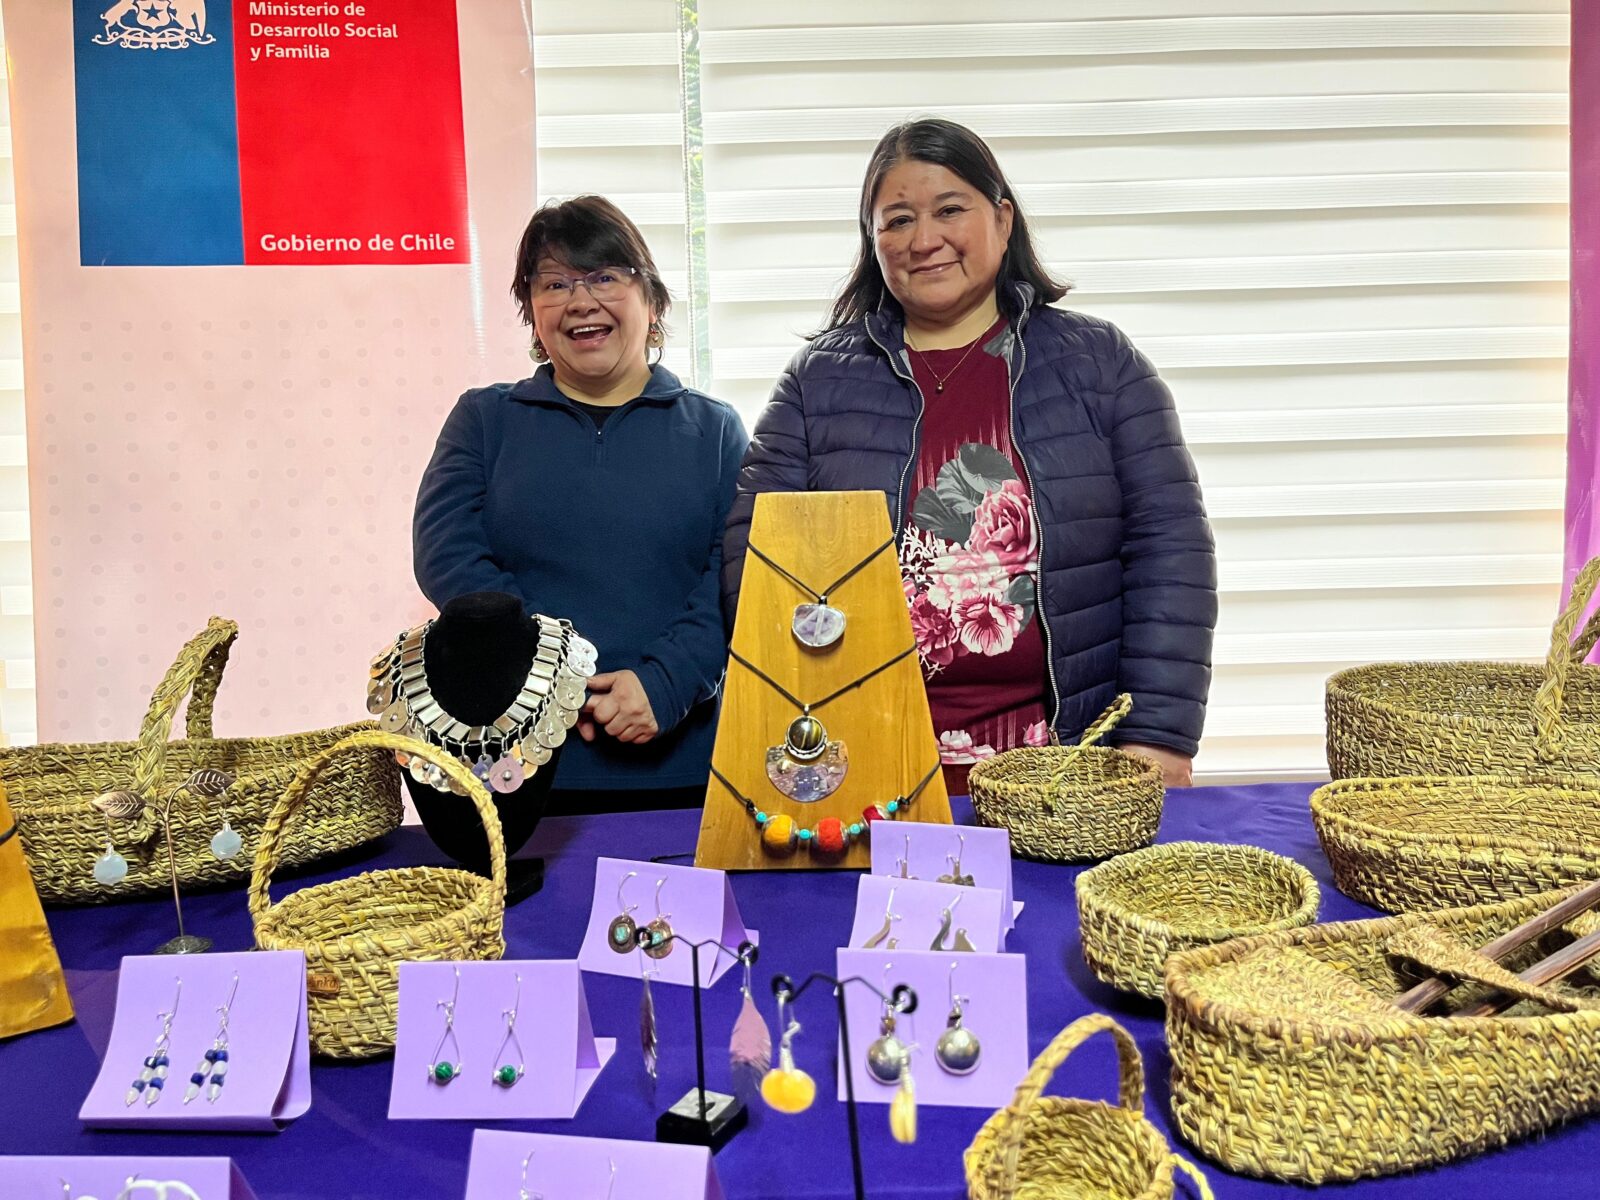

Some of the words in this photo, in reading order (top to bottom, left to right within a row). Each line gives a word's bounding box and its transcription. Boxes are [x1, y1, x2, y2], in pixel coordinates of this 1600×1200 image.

[250, 1, 339, 16] Ministerio
[344, 1, 366, 16] de
[250, 23, 340, 38] Desarrollo
[345, 23, 398, 38] Social
[251, 48, 260, 61] y
[265, 44, 330, 59] Familia
[260, 233, 362, 252] Gobierno
[368, 233, 394, 252] de
[400, 233, 455, 252] Chile
